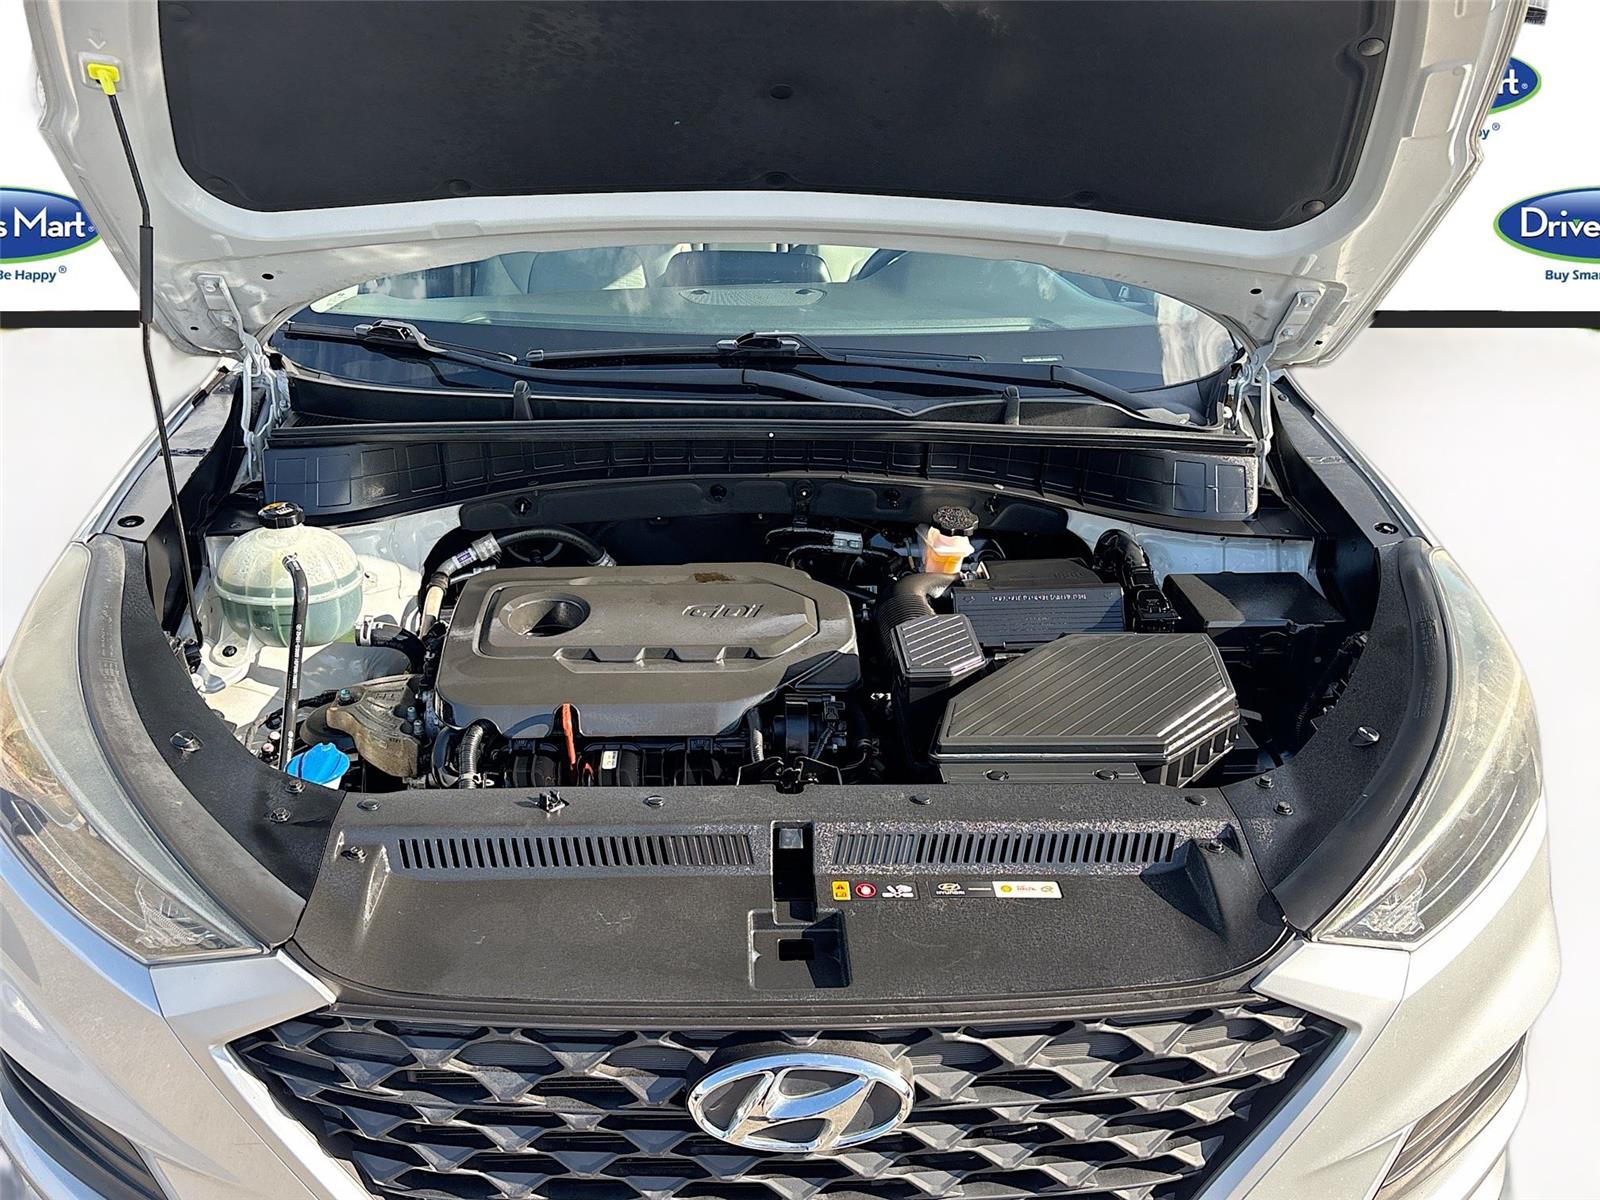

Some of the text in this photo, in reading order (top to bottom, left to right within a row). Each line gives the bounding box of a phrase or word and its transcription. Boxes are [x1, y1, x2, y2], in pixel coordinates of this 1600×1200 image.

[14, 206, 86, 237] Mart
[1521, 206, 1600, 237] Drive
[15, 270, 57, 283] Happy
[1545, 270, 1600, 283] Buy Sma
